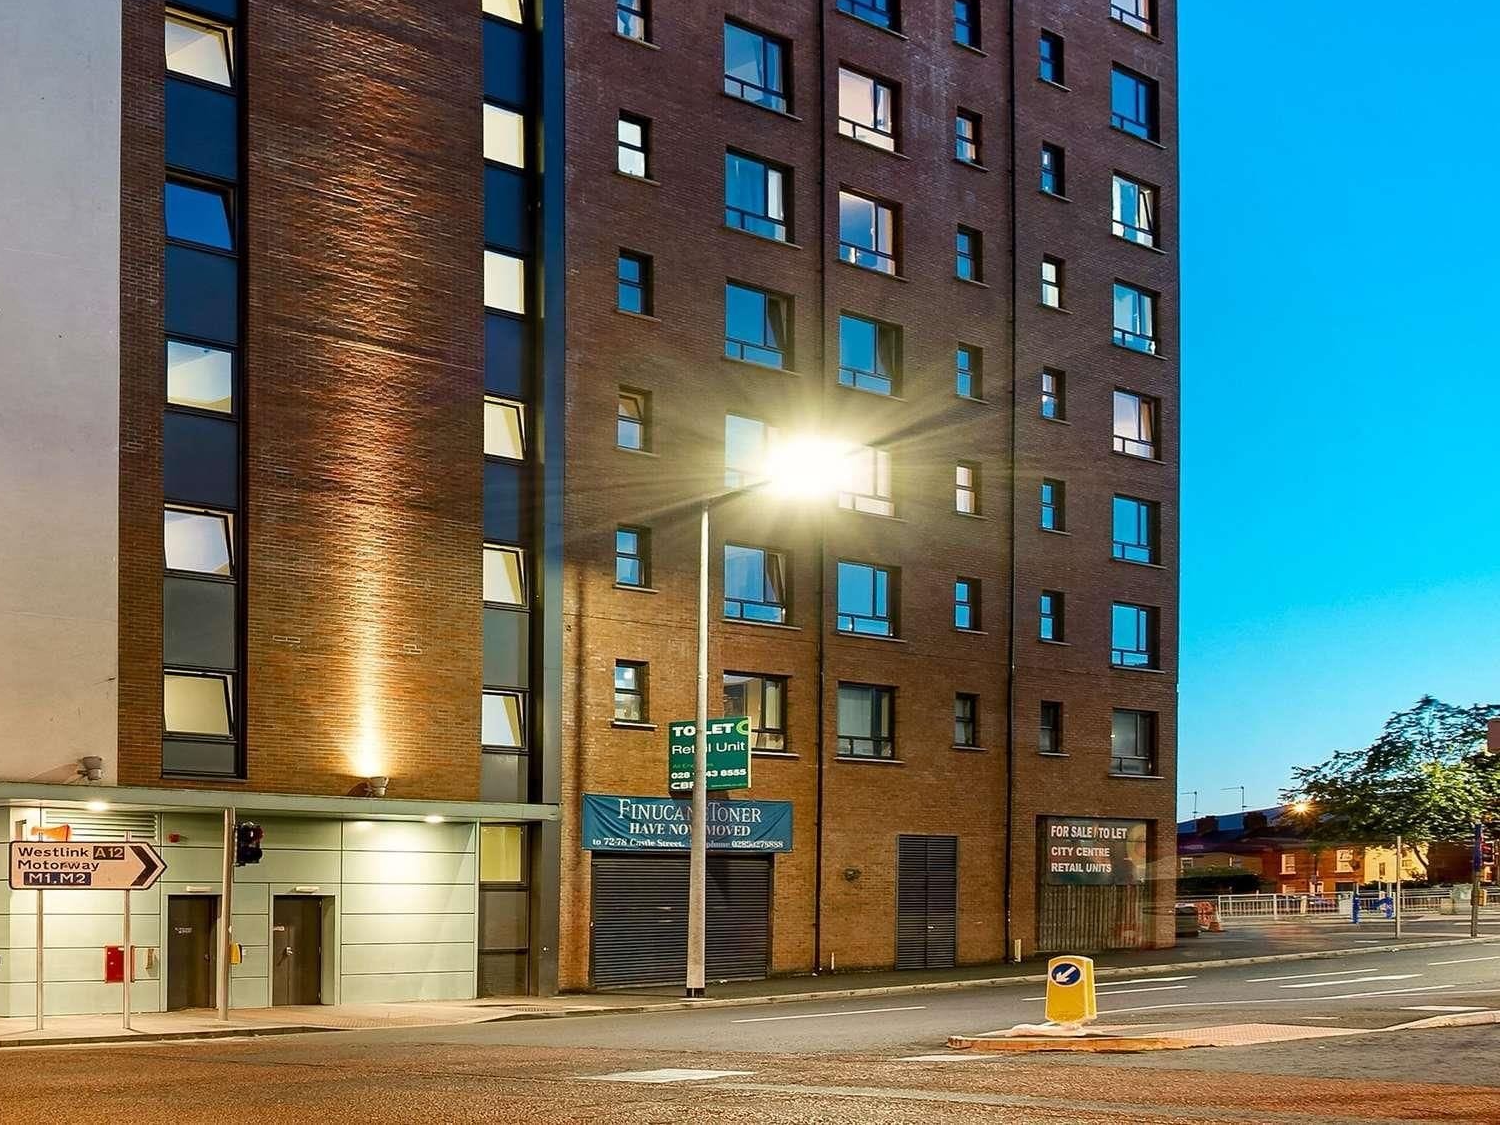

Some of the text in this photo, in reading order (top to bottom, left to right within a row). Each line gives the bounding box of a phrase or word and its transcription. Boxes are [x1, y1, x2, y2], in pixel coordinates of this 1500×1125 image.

[672, 725, 696, 737] TO
[671, 741, 746, 755] Retl Unit
[629, 822, 666, 835] HAVE
[1051, 825, 1069, 837] FOR
[1071, 826, 1093, 838] SALE
[1099, 827, 1110, 839] TO
[1111, 827, 1128, 839] LET
[592, 838, 602, 846] to
[603, 837, 628, 846] 72-78
[18, 846, 125, 858] Westlink A12
[1051, 846, 1111, 857] CITY CENTRE
[17, 859, 100, 872] Motorway
[1051, 862, 1112, 873] RETAIL UNITS
